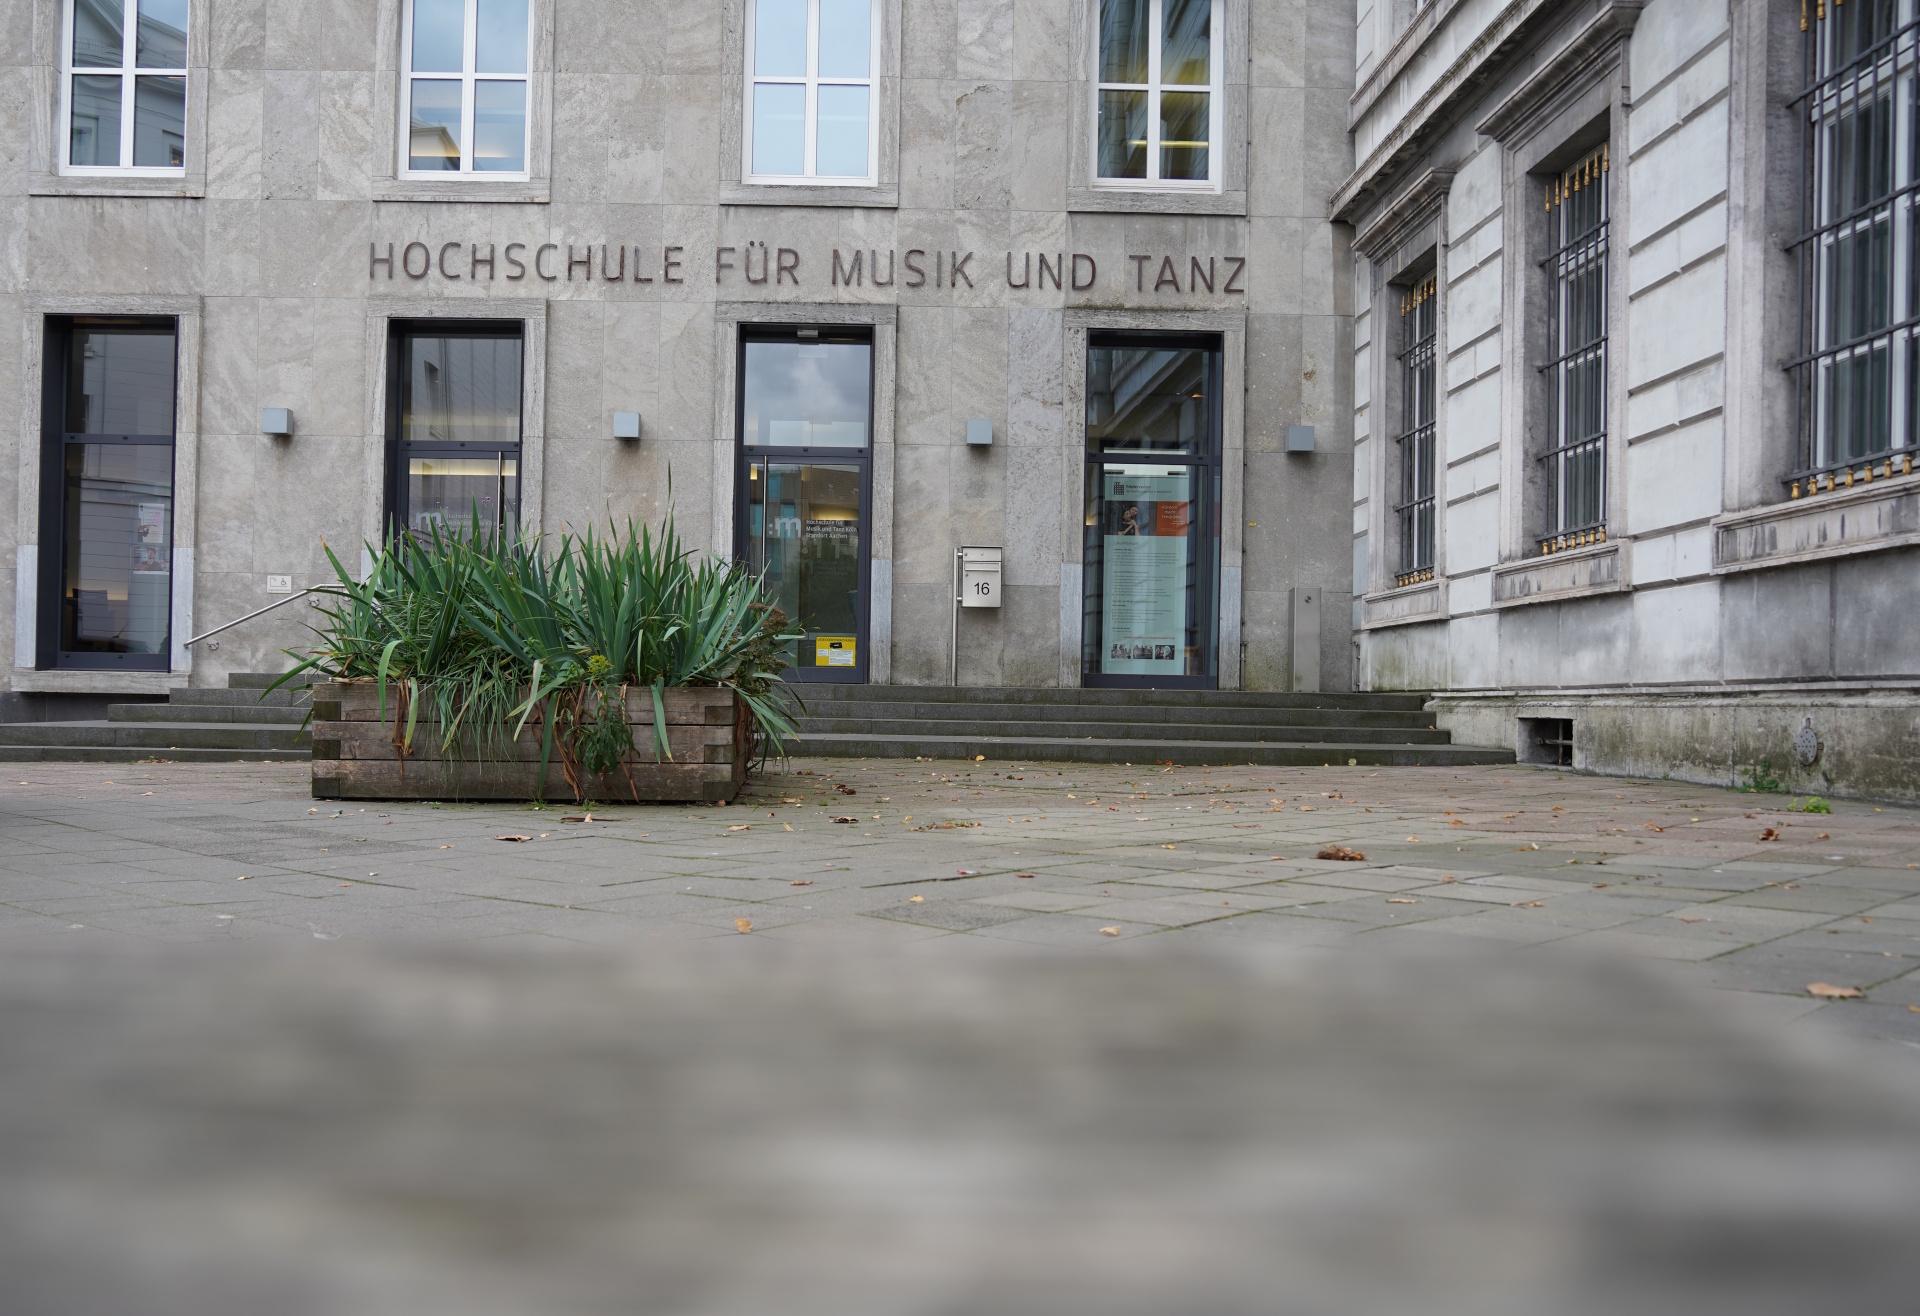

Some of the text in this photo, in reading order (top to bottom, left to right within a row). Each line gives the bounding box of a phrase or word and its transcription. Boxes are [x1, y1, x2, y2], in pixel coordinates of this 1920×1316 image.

[369, 240, 1247, 295] HOCHSCHULE FÜR MUSIK UND TANZ
[974, 582, 990, 596] 16
